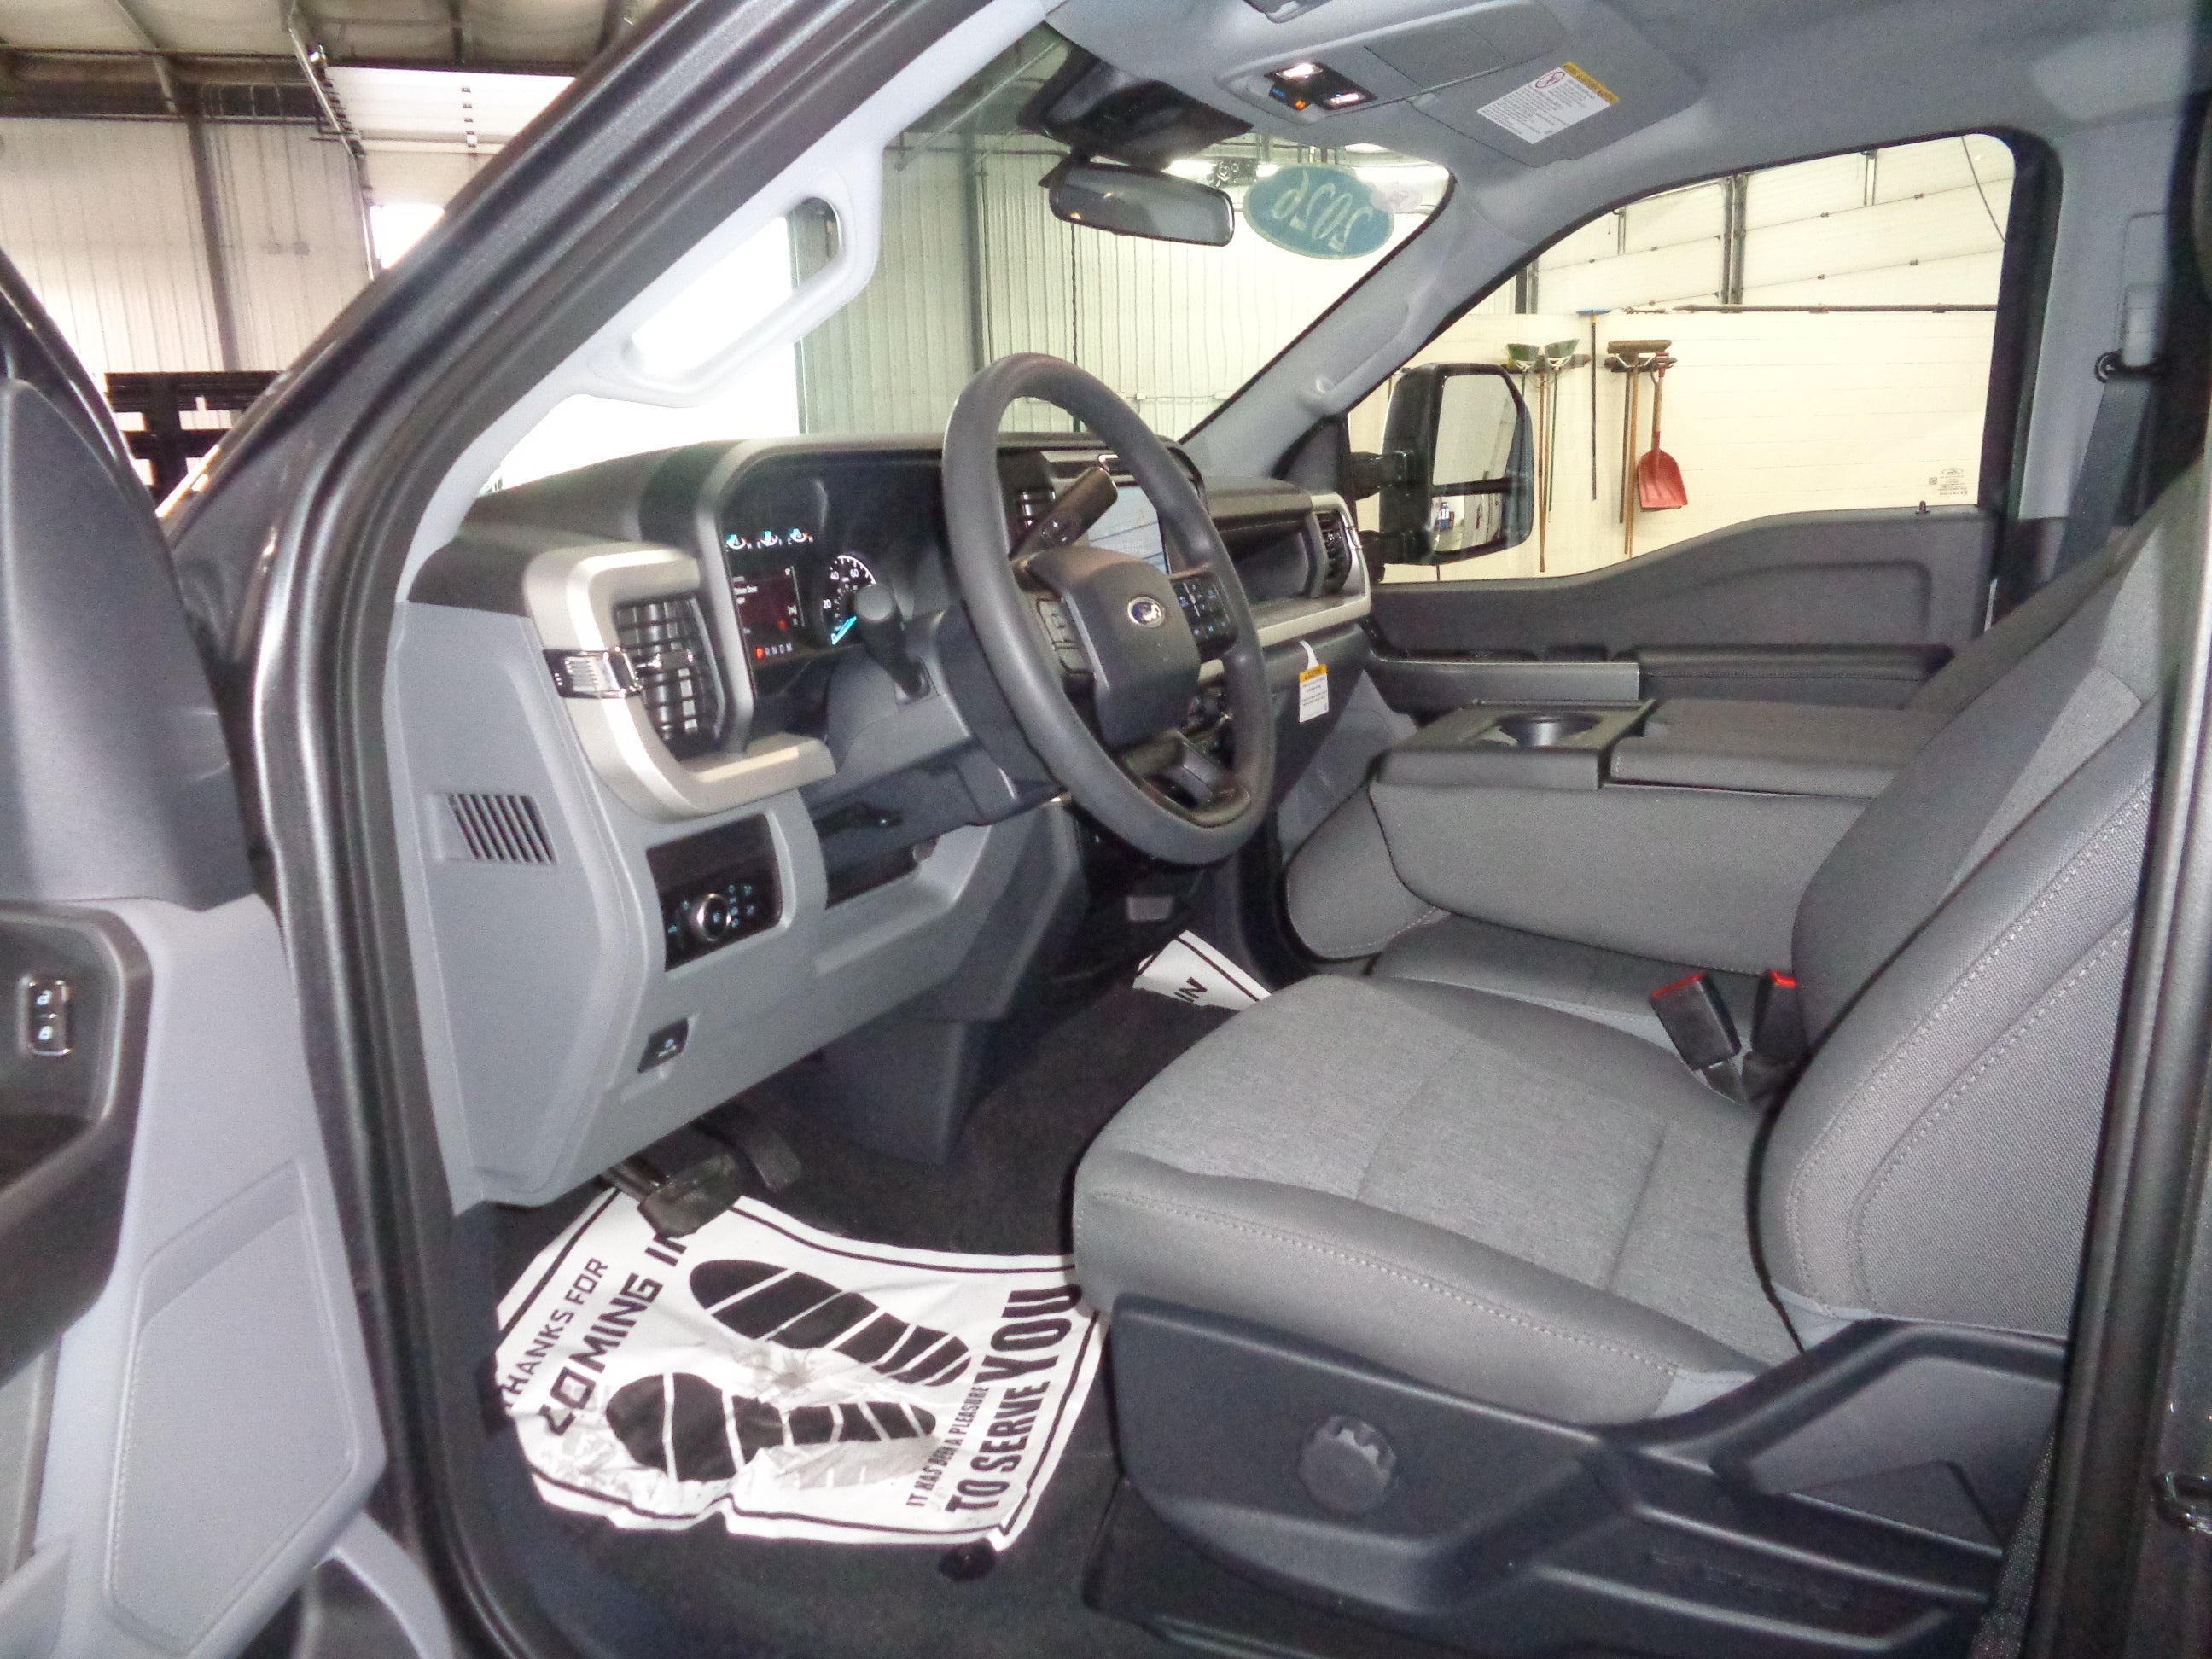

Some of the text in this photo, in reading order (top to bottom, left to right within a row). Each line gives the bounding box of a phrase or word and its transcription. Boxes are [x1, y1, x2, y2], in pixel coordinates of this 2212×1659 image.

[823, 598, 832, 609] 20
[1173, 976, 1208, 1004] IN
[564, 1257, 608, 1306] FOR
[945, 1284, 1082, 1513] TO SERVE YOU
[948, 1385, 991, 1435] PLEASURE
[914, 1466, 943, 1492] HAS
[906, 1493, 928, 1507] IT
